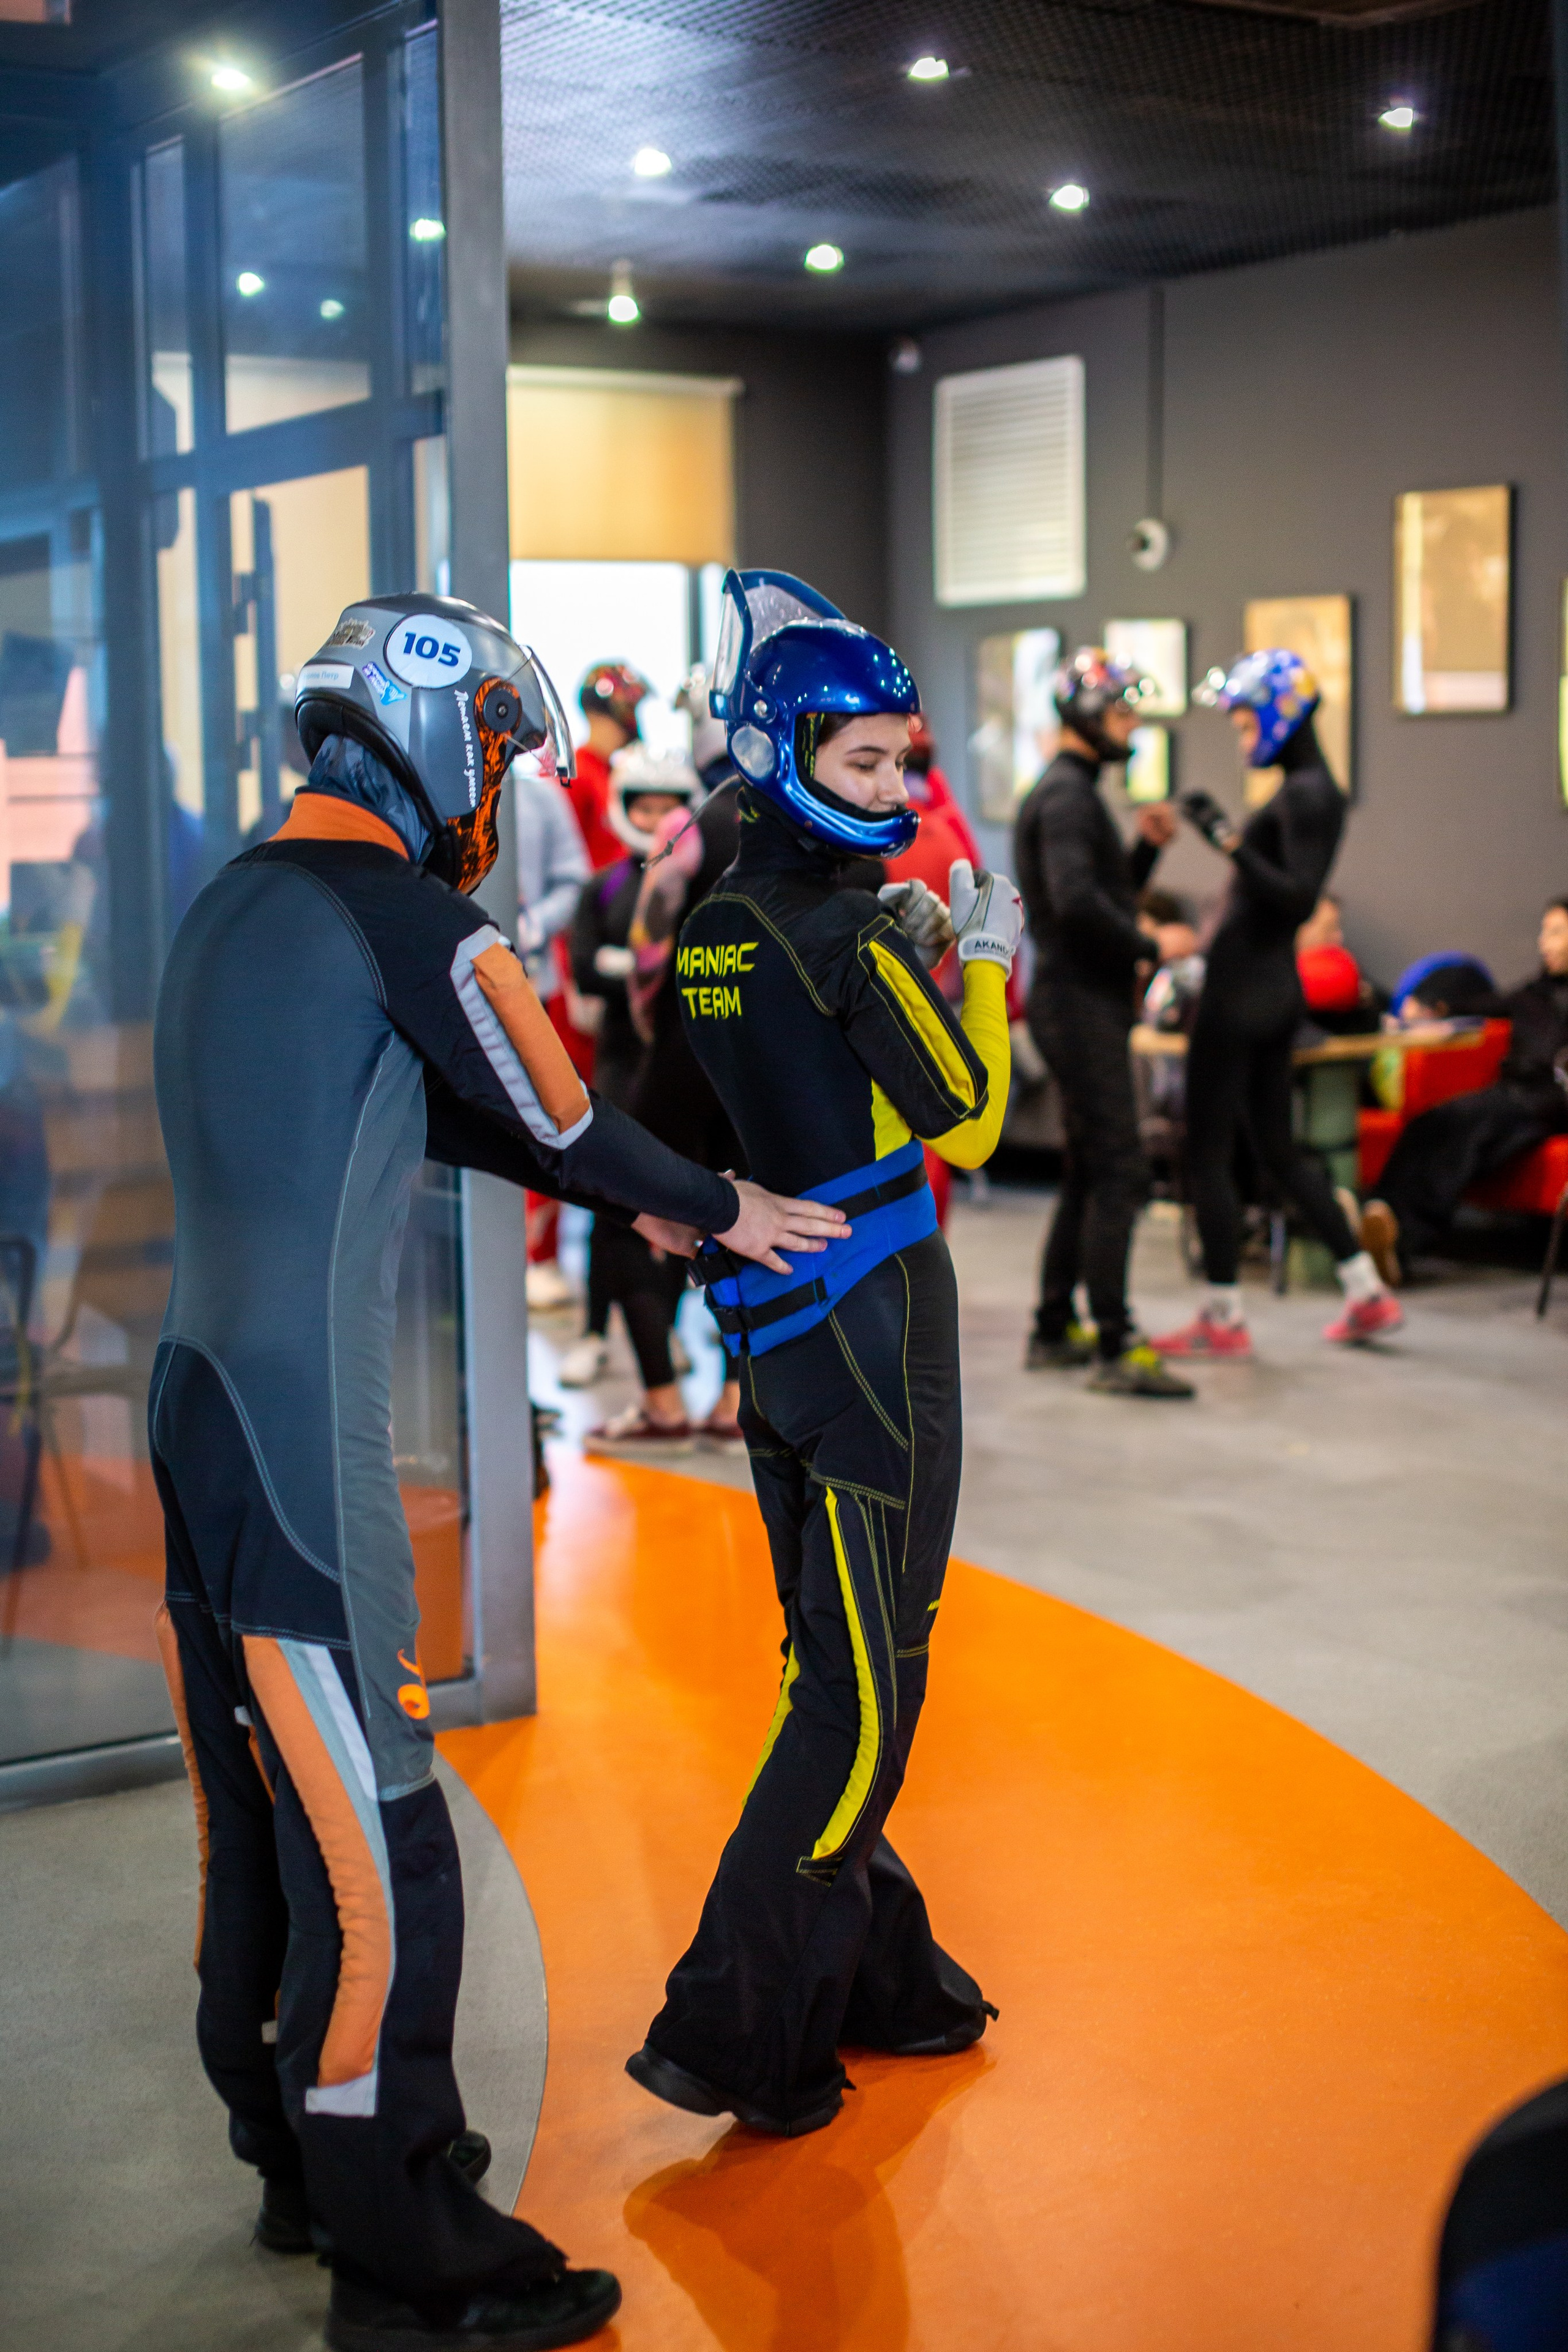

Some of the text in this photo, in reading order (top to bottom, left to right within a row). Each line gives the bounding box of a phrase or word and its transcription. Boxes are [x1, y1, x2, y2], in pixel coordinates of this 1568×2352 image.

[403, 631, 461, 667] 105
[677, 942, 759, 979] MANIAC
[681, 986, 742, 1020] TEAM
